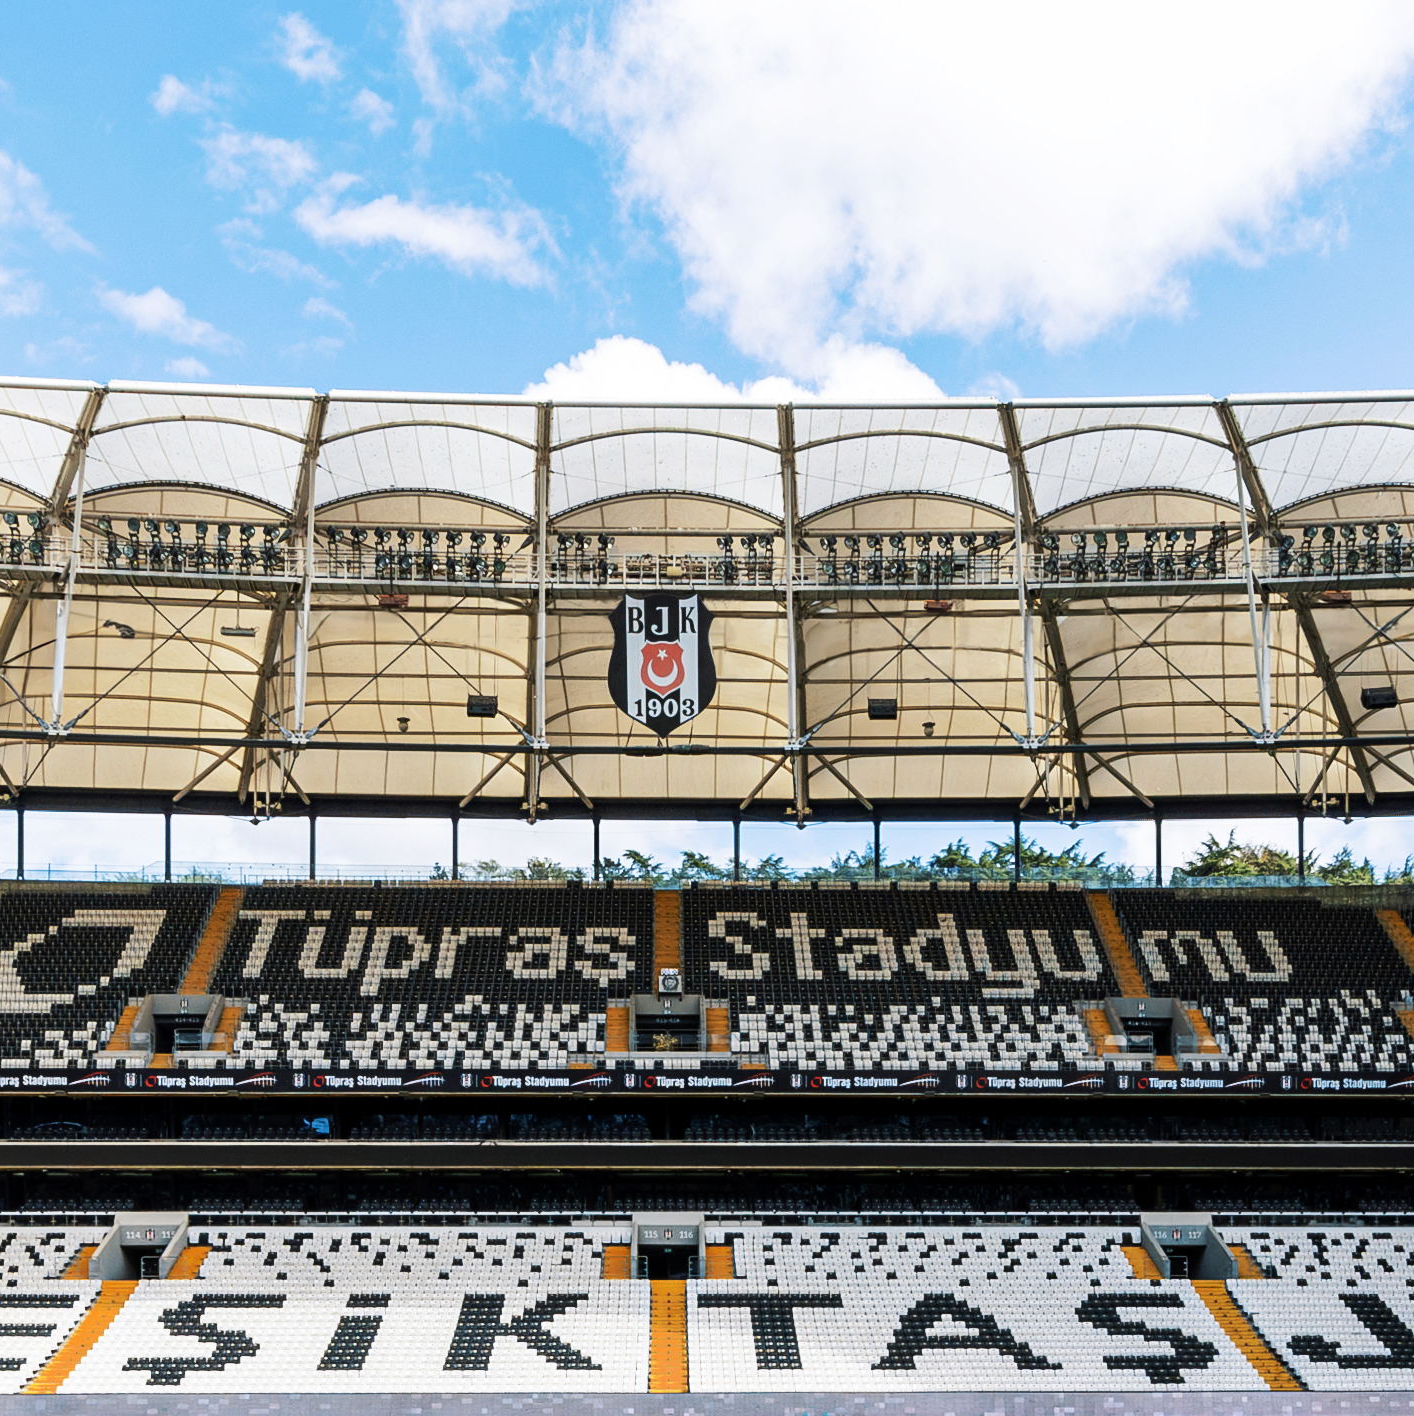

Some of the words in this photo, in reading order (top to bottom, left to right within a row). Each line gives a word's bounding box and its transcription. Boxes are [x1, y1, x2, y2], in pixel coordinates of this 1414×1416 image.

[634, 698, 696, 718] 1903
[238, 909, 637, 997] Tüpraş
[23, 1076, 67, 1087] Stadyumu
[157, 1075, 186, 1089] Tüpraş
[189, 1076, 233, 1088] Stadyumu
[325, 1076, 354, 1089] Tüpraş
[357, 1077, 401, 1088] Stadyumu
[492, 1076, 522, 1089] Tüpraş
[525, 1077, 569, 1088] Stadyumu
[655, 1076, 685, 1089] Tüpraş
[688, 1077, 732, 1088] Stadyumu
[822, 1076, 851, 1089] Tüpraş
[854, 1077, 898, 1088] Stadyumu
[987, 1077, 1016, 1090] Tüpraş
[1019, 1078, 1062, 1089] Stadyumu
[1149, 1078, 1178, 1090] Tüpraş
[1181, 1079, 1224, 1089] Stadyumu
[1311, 1078, 1340, 1090] Tüpraş
[1343, 1079, 1386, 1089] Stadyumu
[644, 1230, 658, 1239] 115
[679, 1230, 694, 1239] 116
